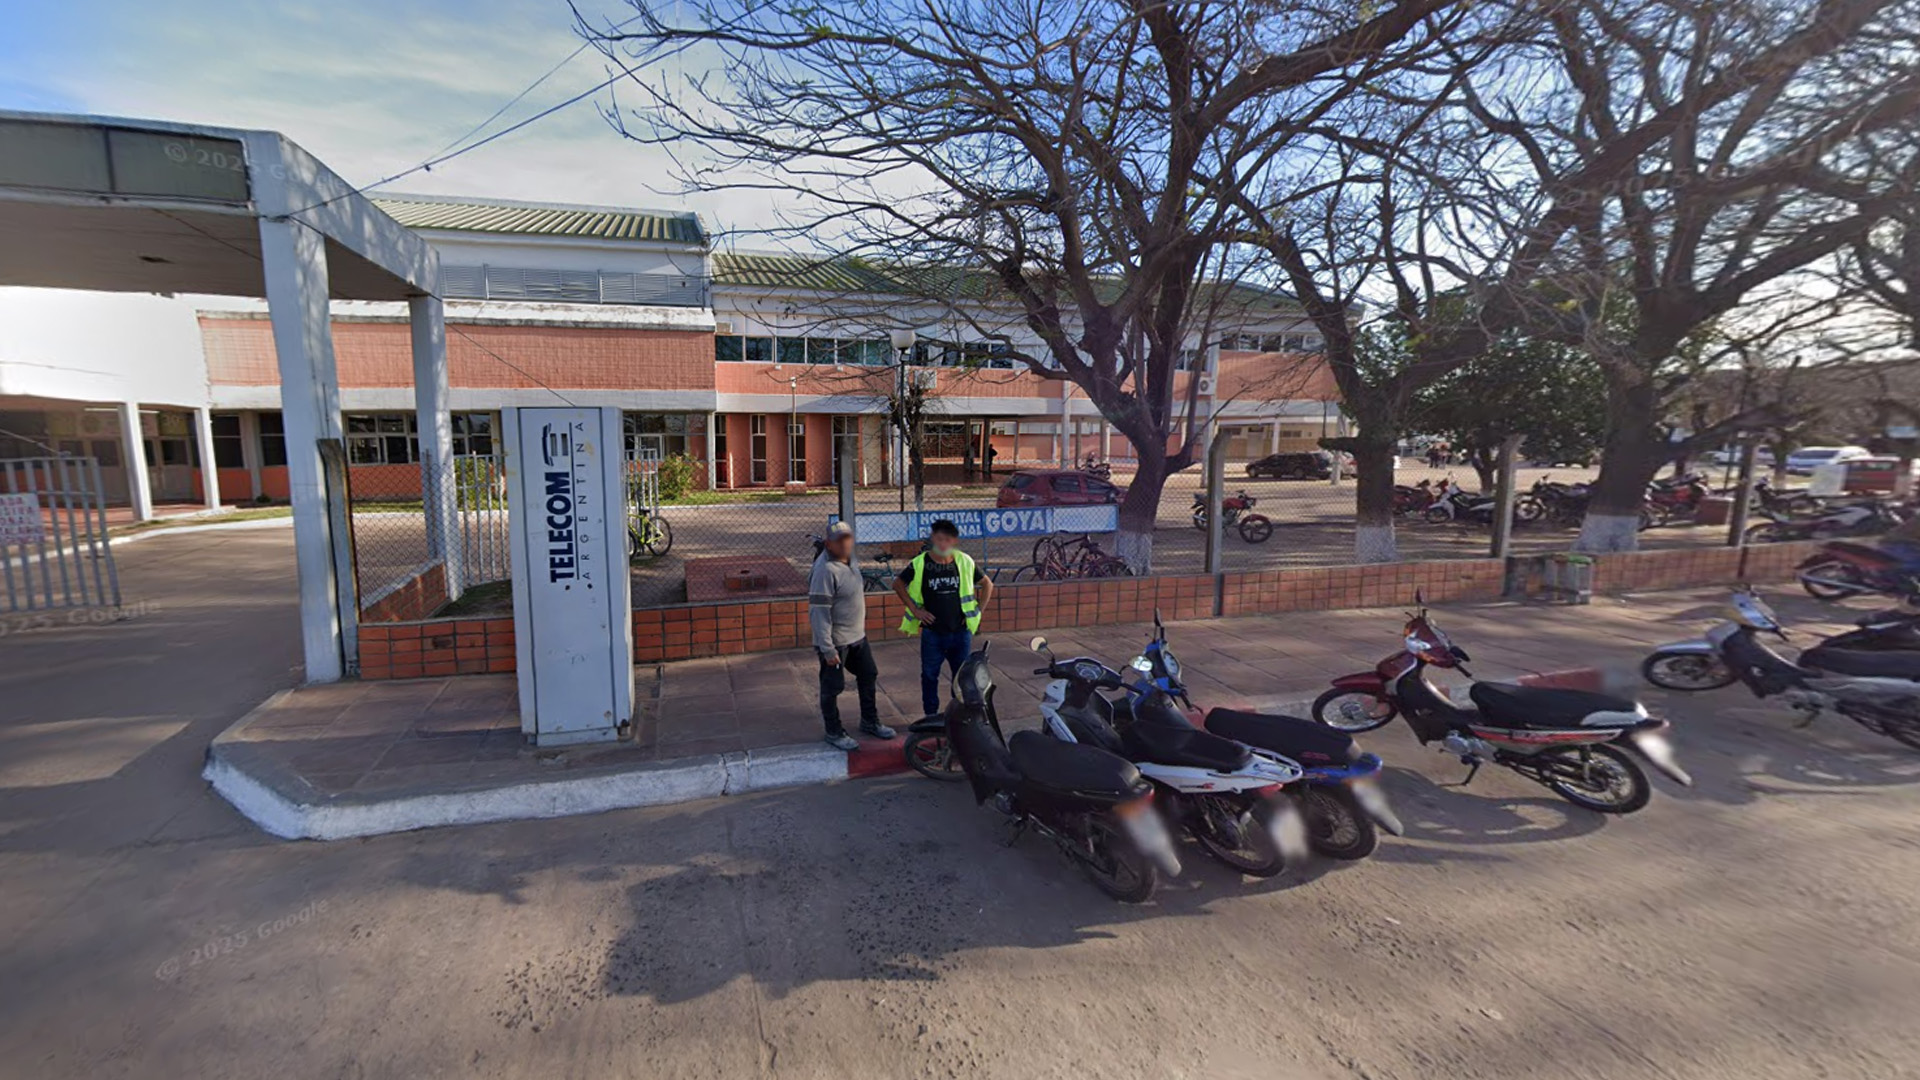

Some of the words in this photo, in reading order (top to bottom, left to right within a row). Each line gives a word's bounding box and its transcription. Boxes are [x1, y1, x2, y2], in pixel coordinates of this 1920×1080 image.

[544, 472, 576, 583] TELECOM
[575, 422, 591, 580] ARGENTINA
[919, 524, 983, 539] RNAL
[985, 510, 1046, 533] GOYA
